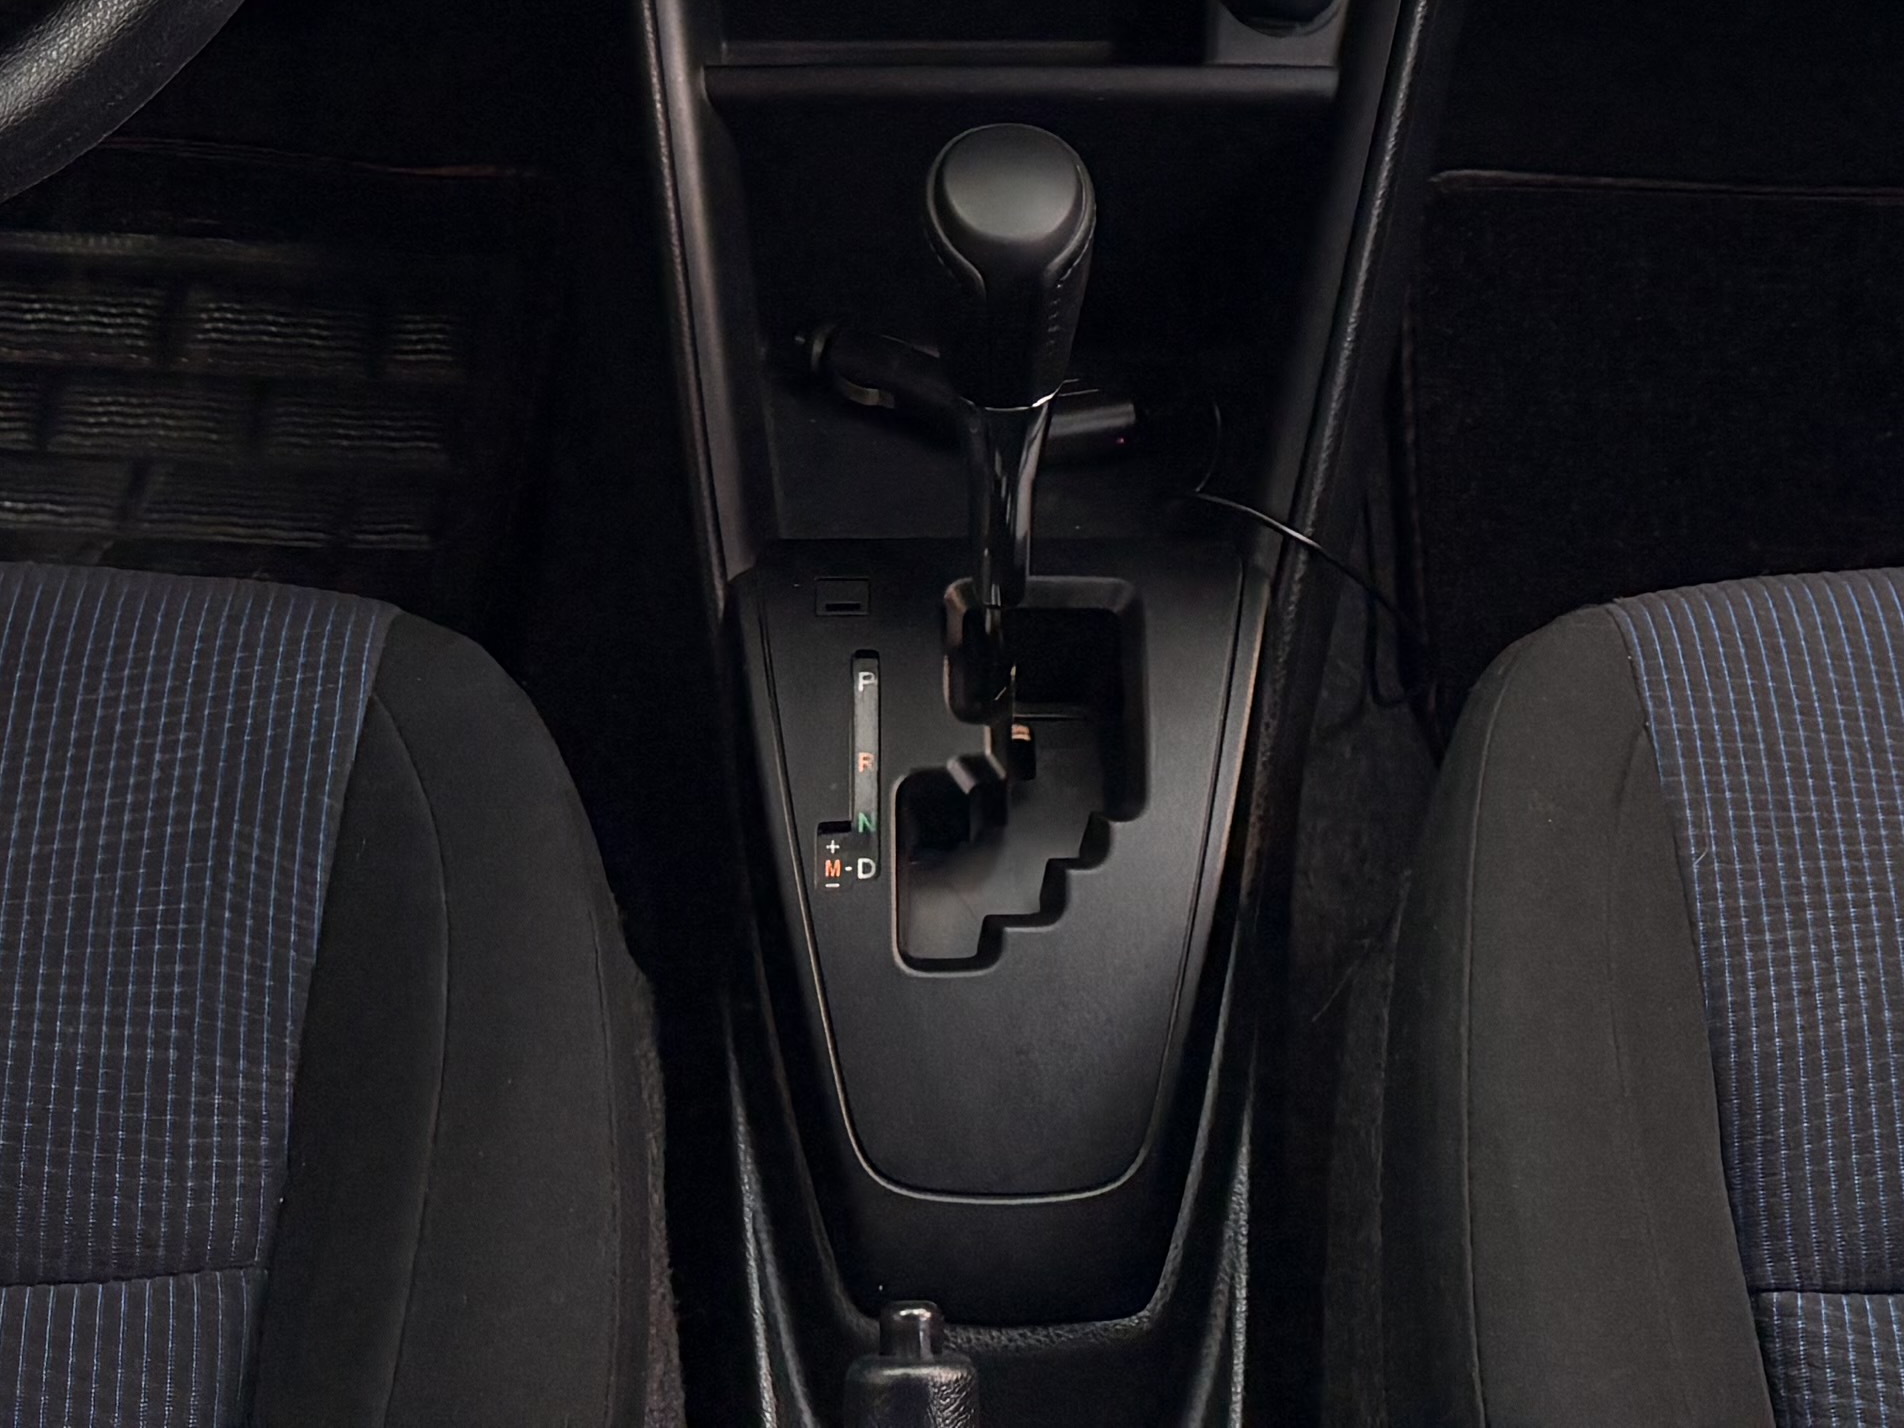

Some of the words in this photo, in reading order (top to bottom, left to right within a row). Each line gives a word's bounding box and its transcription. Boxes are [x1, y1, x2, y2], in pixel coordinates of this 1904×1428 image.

[857, 671, 876, 692] P
[857, 752, 875, 773] R
[857, 812, 876, 833] N
[857, 857, 877, 879] D
